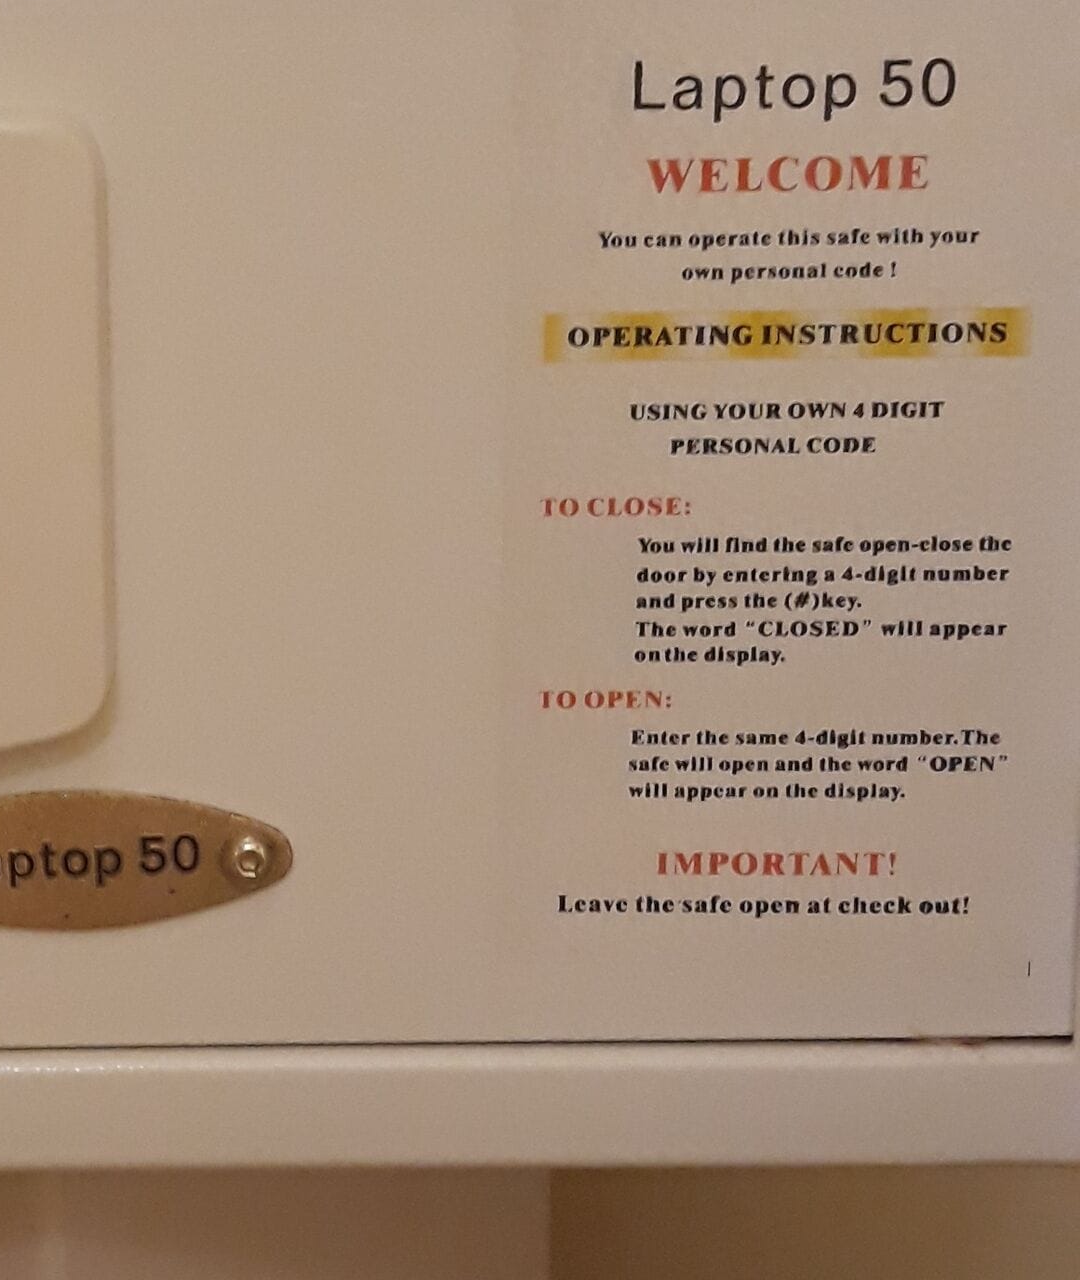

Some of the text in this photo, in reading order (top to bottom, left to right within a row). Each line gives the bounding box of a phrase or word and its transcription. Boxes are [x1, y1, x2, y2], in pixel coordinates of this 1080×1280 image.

[633, 57, 956, 124] Laptop 50
[646, 155, 929, 194] WELCOME
[598, 227, 980, 252] You can operate this safe with your
[681, 267, 724, 281] own
[730, 262, 827, 285] personal
[833, 261, 884, 279] code
[567, 321, 1008, 348] OPERATING INSTRUCTIONS
[630, 401, 945, 421] USING YOUR OWN 4 DIGIT
[670, 436, 876, 455] PERSONAL CODE
[543, 497, 691, 517] TO CLOSE:
[638, 535, 1012, 557] You will find the safe open-close the
[636, 565, 1010, 587] door by entering a 4-digit number
[636, 592, 675, 609] and
[681, 596, 738, 613] press
[744, 592, 778, 609] the
[635, 621, 677, 638] The
[682, 621, 736, 638] word
[881, 620, 923, 637] will
[929, 623, 1008, 641] appear
[703, 645, 785, 667] display.
[542, 690, 672, 709] TO OPEN:
[631, 729, 691, 746] Enter
[696, 729, 729, 746] the
[735, 733, 789, 746] same
[794, 728, 866, 749] 4-digit
[628, 756, 670, 772] safe
[674, 756, 713, 772] will
[718, 759, 769, 776] open
[774, 756, 813, 772] and
[819, 756, 852, 772] the
[857, 755, 909, 773] word
[628, 782, 906, 803] will appear on the display.
[137, 833, 201, 877] 50
[657, 851, 897, 876] IMPORTANT!
[558, 894, 970, 919] Leave the safe open at check out!
